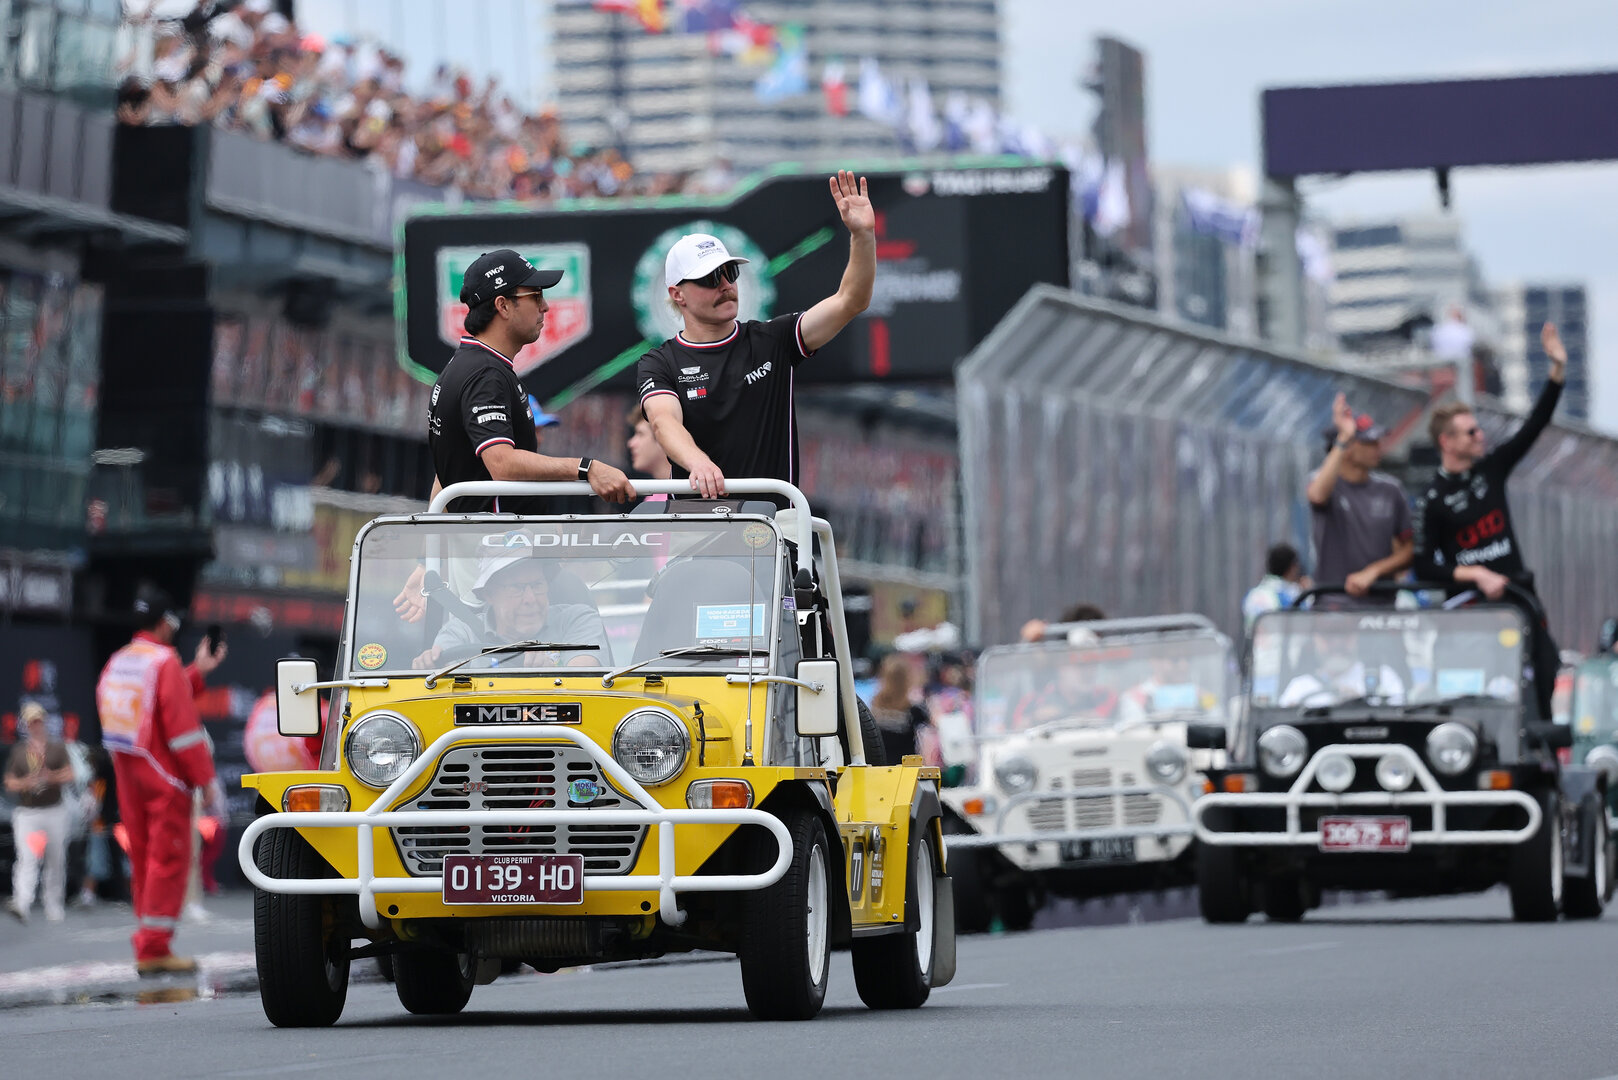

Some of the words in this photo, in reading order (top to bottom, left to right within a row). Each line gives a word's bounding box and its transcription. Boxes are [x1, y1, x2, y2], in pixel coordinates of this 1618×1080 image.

[744, 366, 767, 384] TWG
[481, 532, 663, 548] CADILLAC
[478, 706, 558, 722] MOKE
